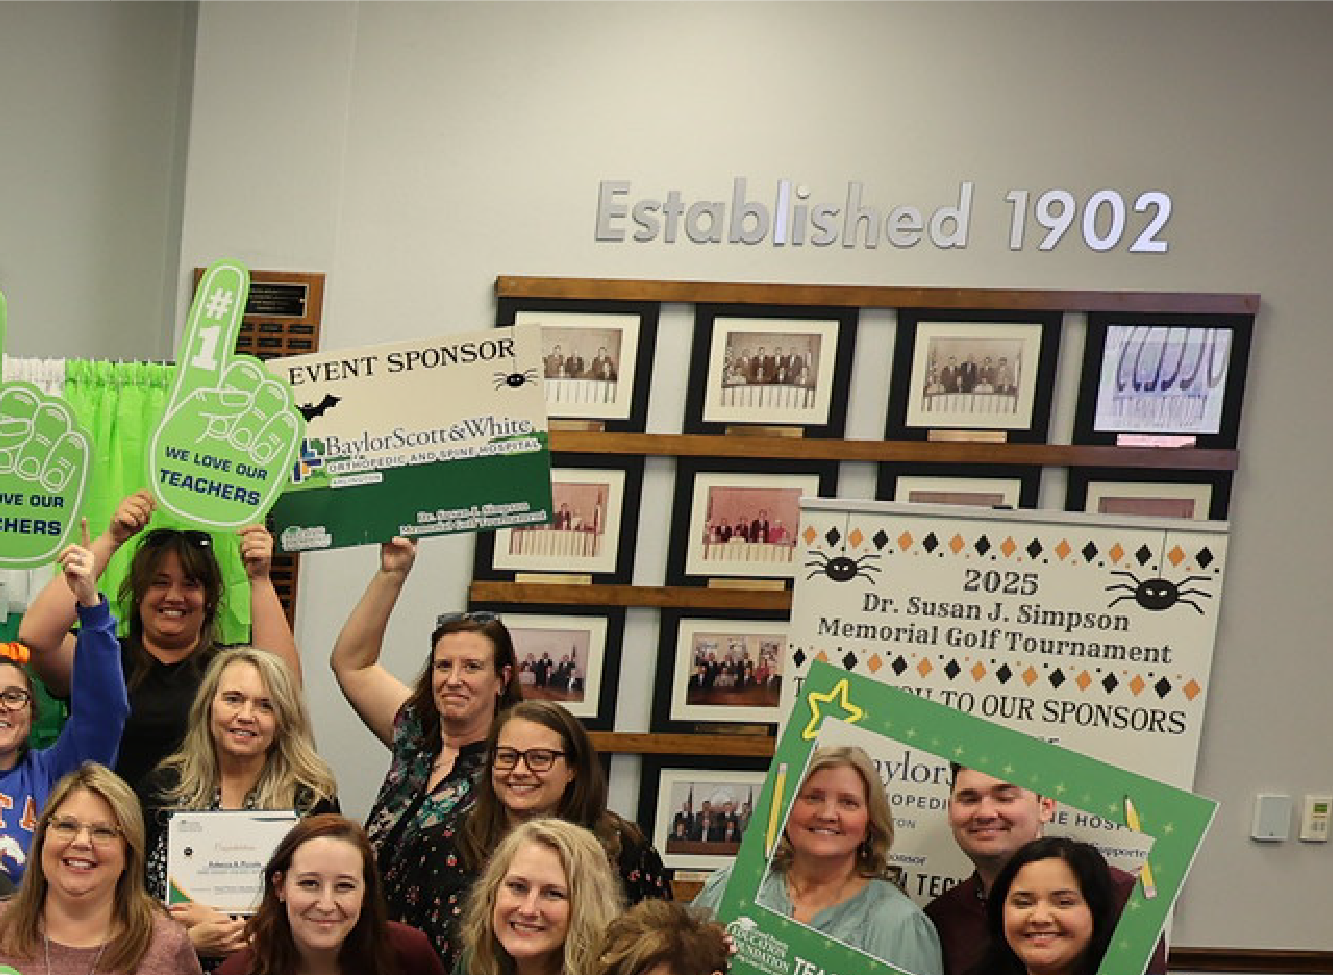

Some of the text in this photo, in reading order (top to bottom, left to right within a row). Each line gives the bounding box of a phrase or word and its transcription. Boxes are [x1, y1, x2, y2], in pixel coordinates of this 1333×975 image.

[594, 177, 1172, 252] Established 1902
[288, 336, 516, 387] EVENT SPONSOR
[165, 446, 268, 481] WE LOVE OUR
[30, 494, 64, 509] OUR
[159, 468, 261, 507] TEACHERS
[962, 568, 1040, 597] 2025
[862, 592, 1131, 633] Dr. Susan J. Simpson
[816, 616, 1173, 664] Memorial Golf Tournament
[981, 691, 1036, 722] OUR
[1041, 696, 1188, 736] SPONSORS
